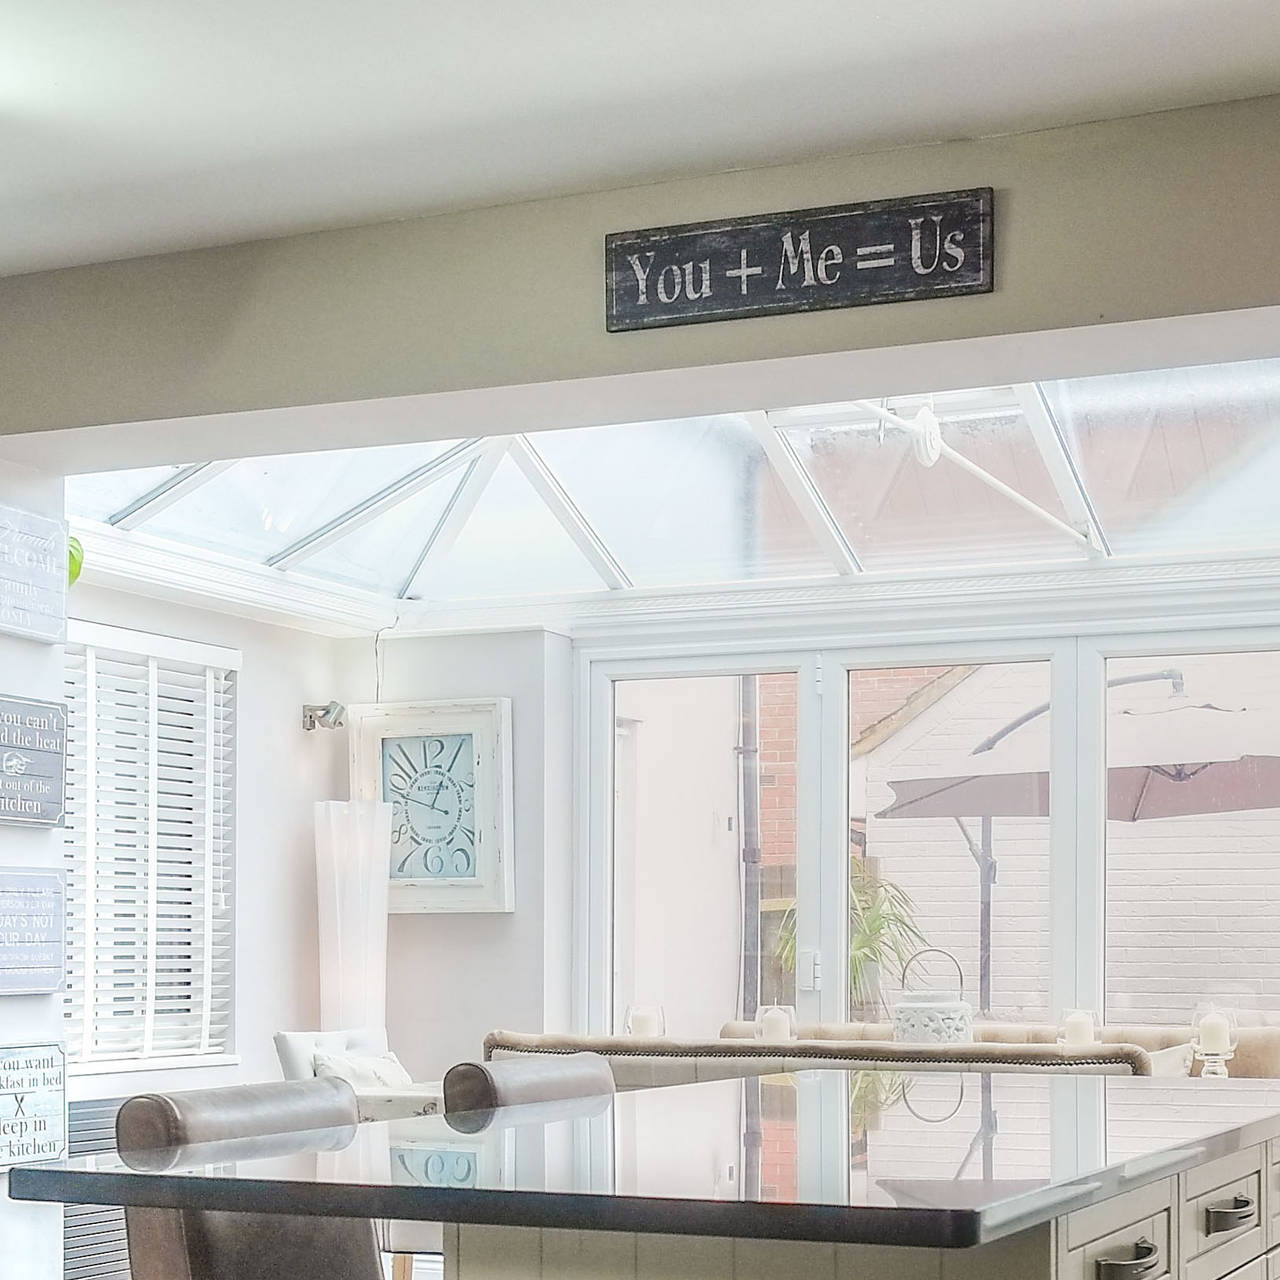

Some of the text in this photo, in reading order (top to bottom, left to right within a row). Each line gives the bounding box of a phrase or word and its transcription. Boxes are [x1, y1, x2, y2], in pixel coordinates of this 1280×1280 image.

[628, 215, 965, 304] You + Me = Us
[26, 713, 58, 732] can't
[13, 728, 31, 746] the
[36, 732, 61, 750] heat
[423, 739, 445, 769] 12
[5, 780, 21, 790] out
[24, 780, 34, 792] of
[36, 780, 50, 793] the
[423, 846, 444, 874] 6
[32, 912, 54, 929] NOT
[25, 932, 47, 947] DAY
[25, 1056, 54, 1070] want
[28, 1073, 39, 1088] in
[43, 1071, 62, 1086] bed
[34, 1113, 47, 1132] in
[9, 1137, 56, 1157] kitchen
